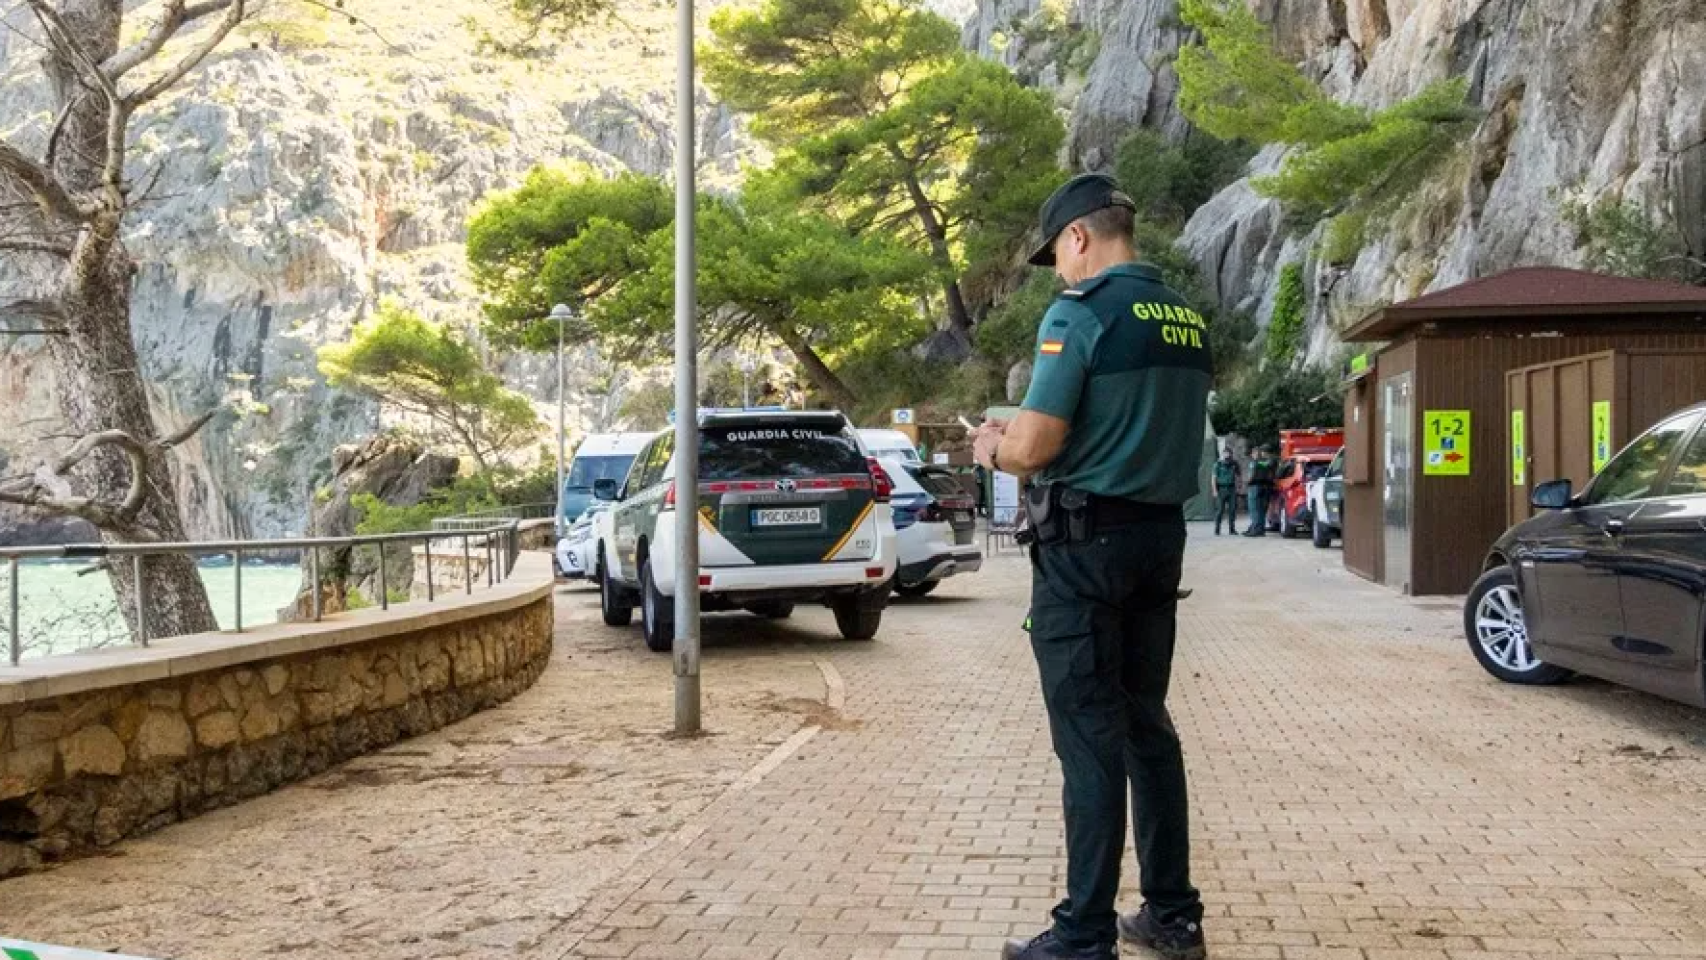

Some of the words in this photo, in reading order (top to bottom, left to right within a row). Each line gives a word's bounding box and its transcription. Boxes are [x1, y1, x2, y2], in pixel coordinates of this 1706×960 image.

[1162, 325, 1202, 348] CIVIL
[1430, 418, 1464, 436] 1-2
[727, 429, 789, 441] GUARDIA
[792, 429, 824, 440] CIVIL
[761, 510, 781, 523] PGC
